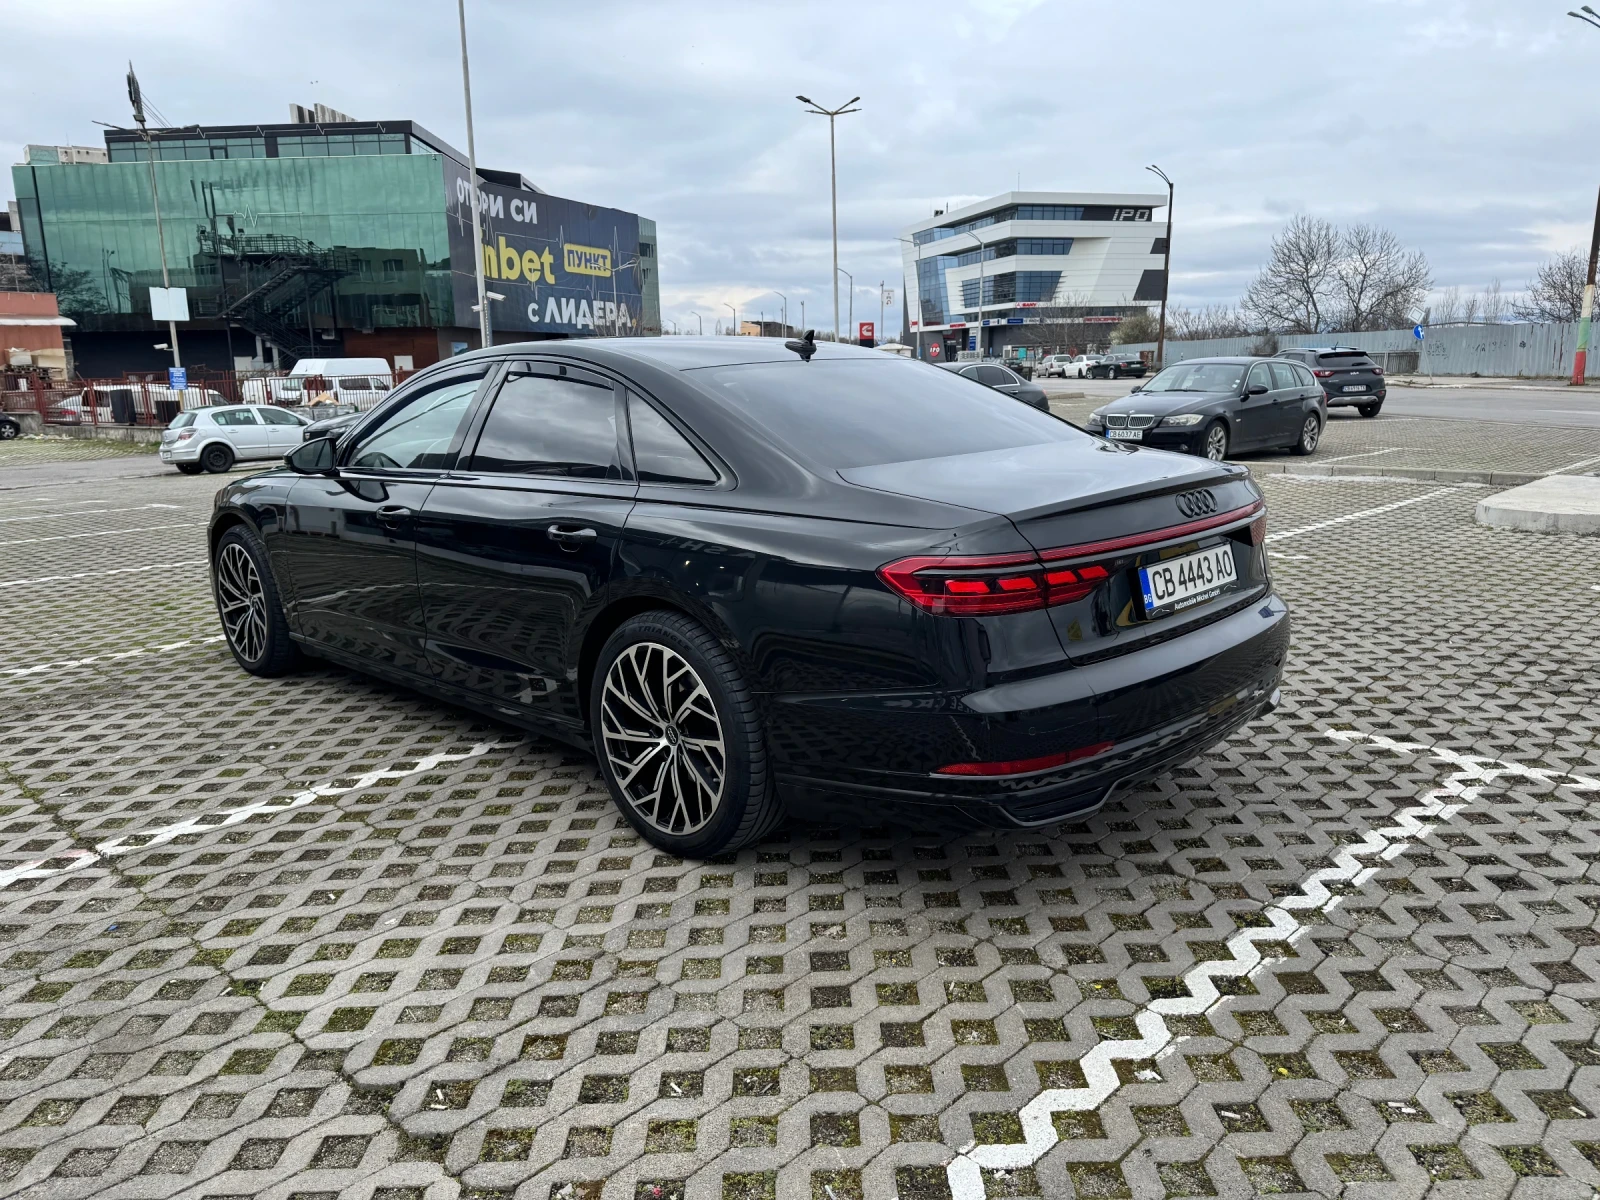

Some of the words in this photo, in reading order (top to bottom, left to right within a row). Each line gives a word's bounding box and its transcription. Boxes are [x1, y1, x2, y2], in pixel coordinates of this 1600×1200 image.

[456, 177, 504, 219] ОТОРИ
[510, 198, 538, 225] СИ
[1112, 208, 1150, 221] IPO
[567, 249, 608, 271] ПУНКТ
[1152, 567, 1176, 600] CB
[1179, 555, 1214, 592] 4443
[1215, 549, 1233, 581] AO
[1144, 594, 1152, 603] BG
[637, 625, 692, 651] TRIANGLE
